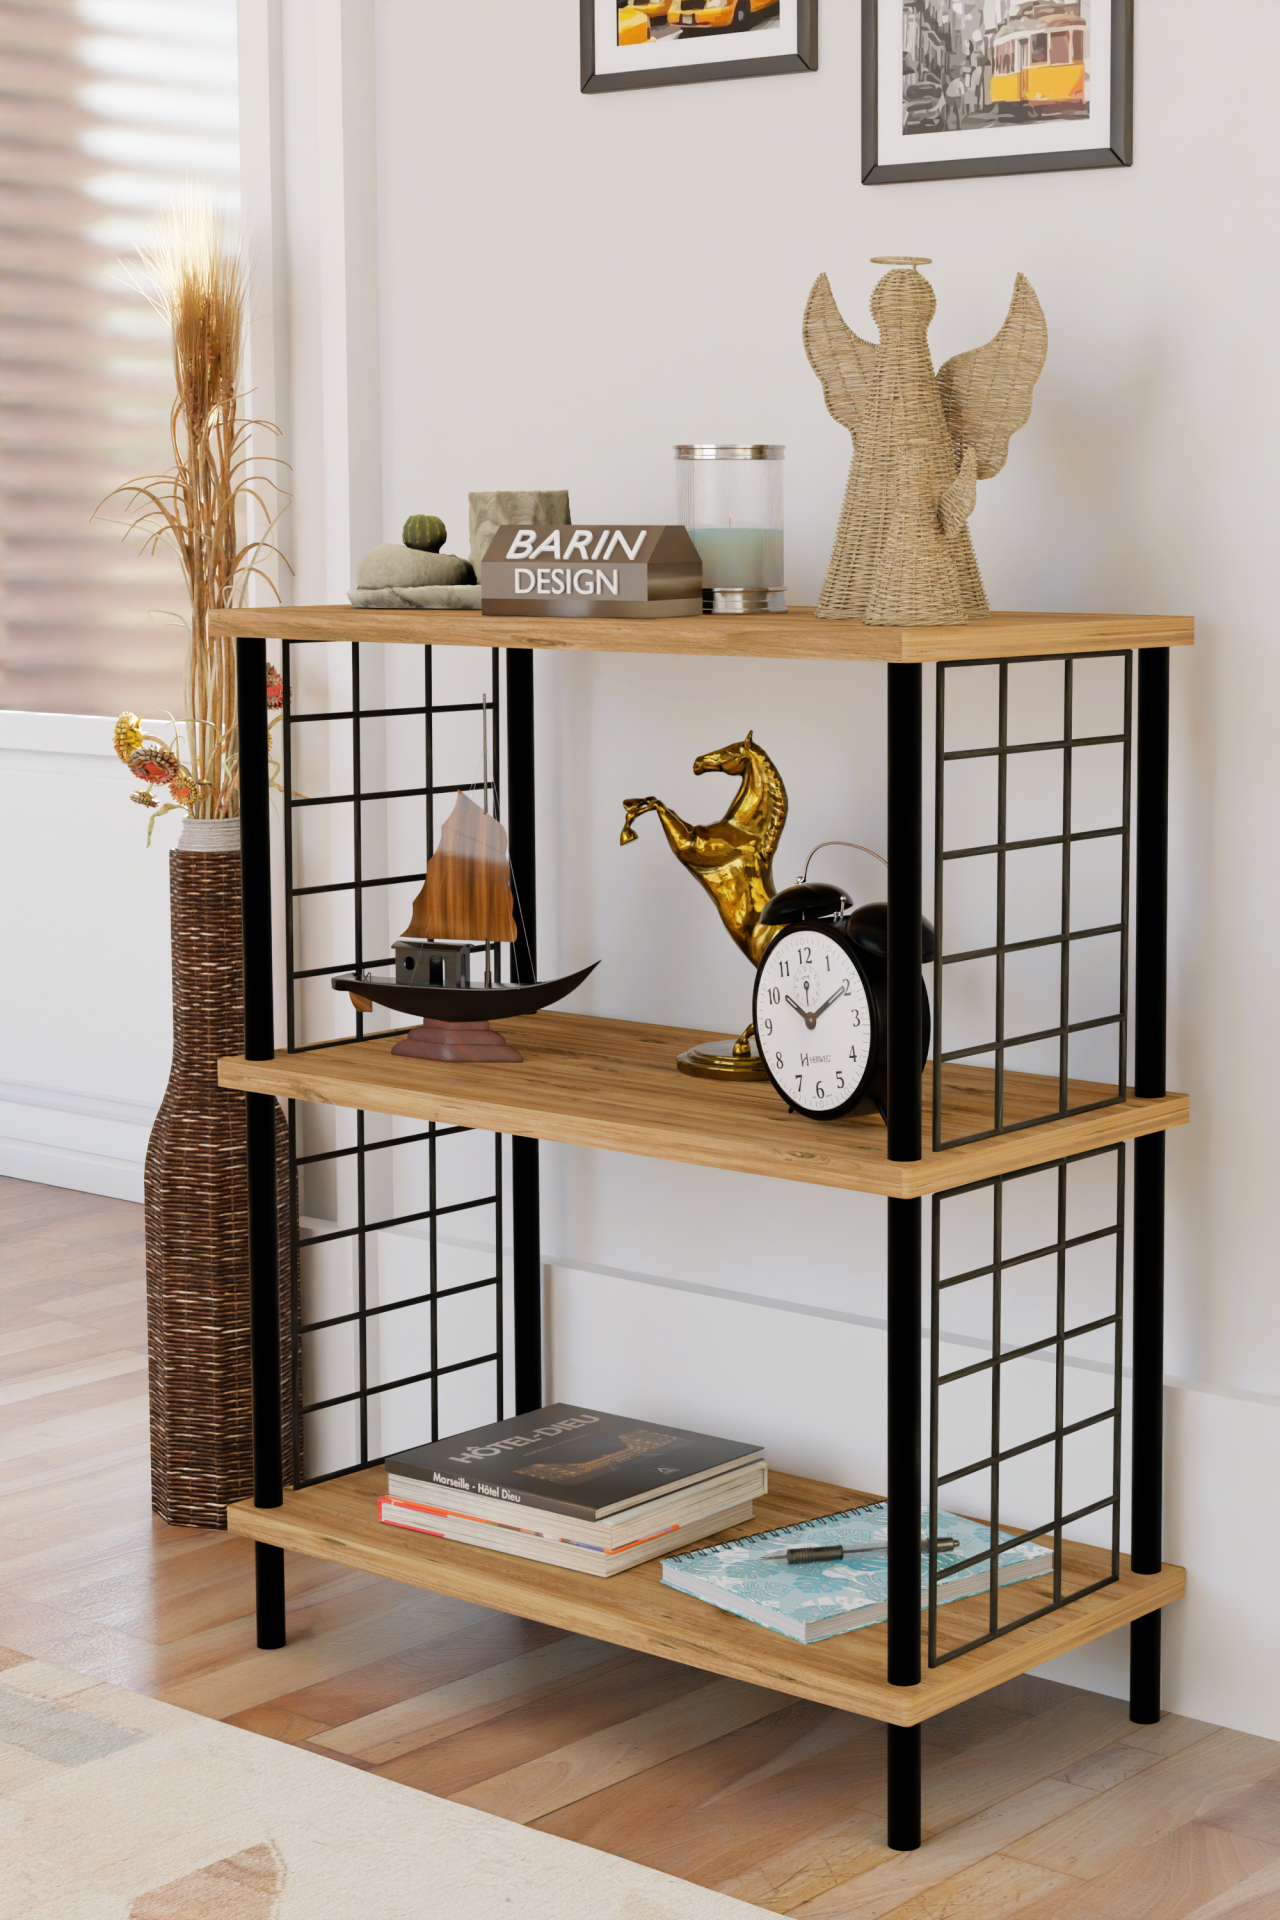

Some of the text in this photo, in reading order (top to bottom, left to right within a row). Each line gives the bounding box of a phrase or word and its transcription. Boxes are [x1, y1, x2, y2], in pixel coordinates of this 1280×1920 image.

[505, 529, 647, 560] BARIN
[514, 568, 619, 595] DESIGN
[797, 947, 812, 964] 12
[825, 955, 830, 971] 1
[778, 960, 790, 977] 11
[767, 987, 780, 1005] 10
[843, 979, 851, 996] 2
[765, 1018, 773, 1036] 9
[852, 1009, 860, 1027] 3
[776, 1052, 783, 1069] 8
[849, 1045, 857, 1062] 4
[795, 1074, 803, 1092] 7
[836, 1071, 844, 1088] 5
[816, 1081, 824, 1099] 6
[448, 1414, 600, 1464] HÔTEL-DIEU
[433, 1471, 470, 1490] Marseille
[477, 1482, 499, 1498] Hôtel
[501, 1488, 521, 1502] Dieu
